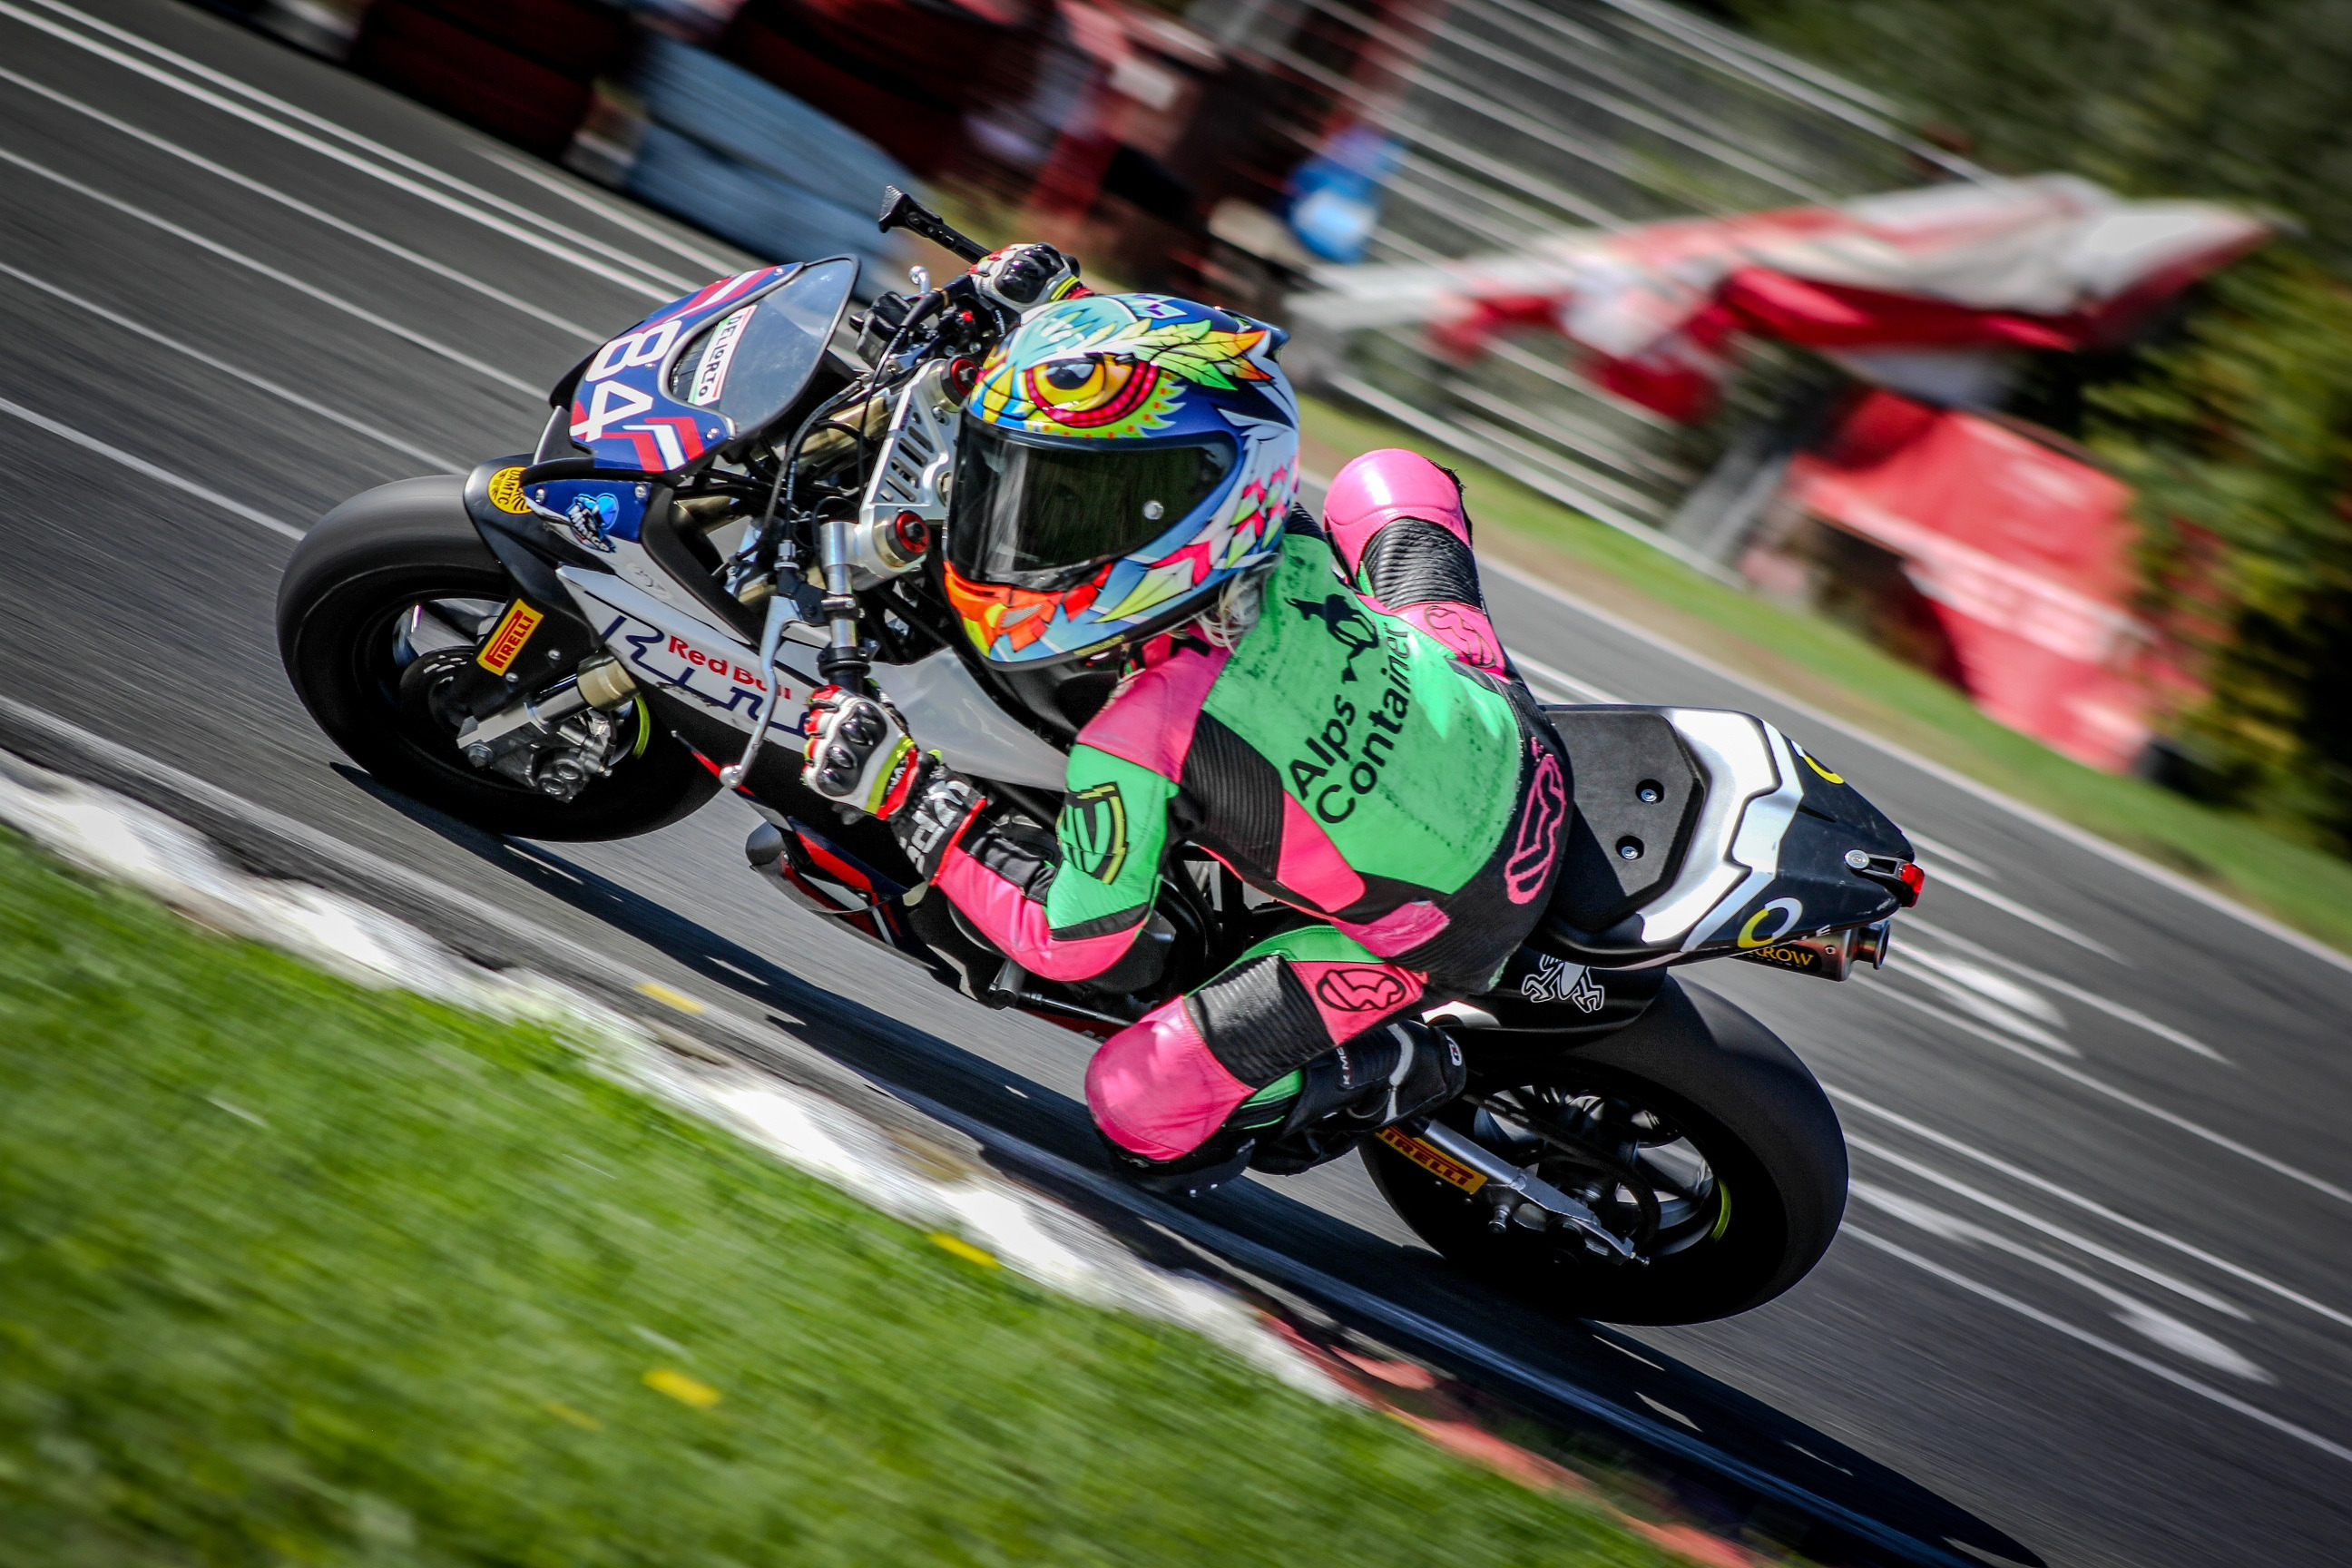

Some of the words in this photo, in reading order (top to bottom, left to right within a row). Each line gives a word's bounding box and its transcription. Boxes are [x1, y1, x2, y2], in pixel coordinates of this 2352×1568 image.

[568, 318, 682, 443] 84
[484, 609, 535, 669] PIRELLI
[668, 635, 730, 677] Red
[1289, 694, 1356, 800] Alps
[1317, 622, 1412, 824] Container
[1749, 946, 1814, 966] ROW
